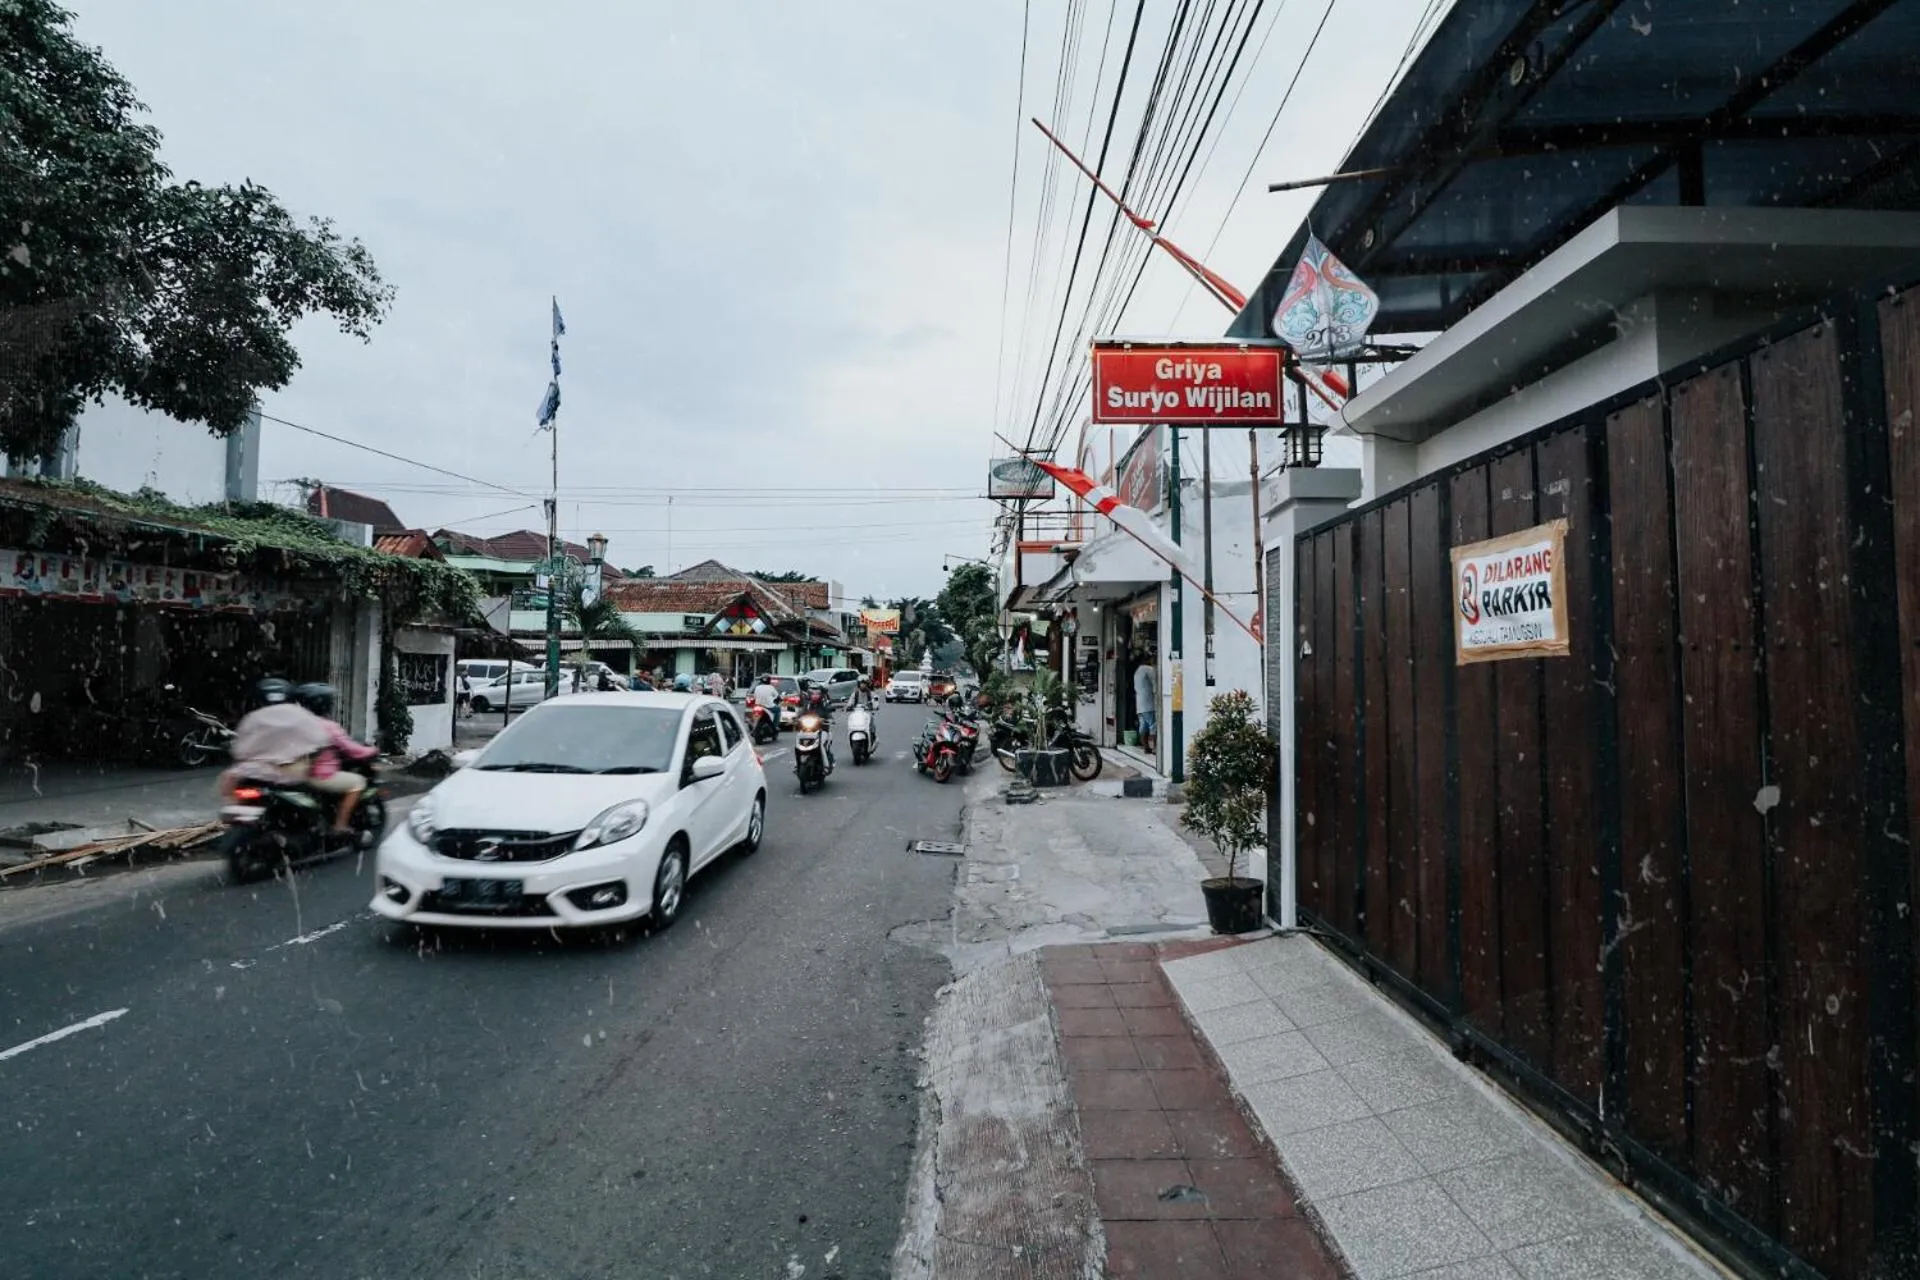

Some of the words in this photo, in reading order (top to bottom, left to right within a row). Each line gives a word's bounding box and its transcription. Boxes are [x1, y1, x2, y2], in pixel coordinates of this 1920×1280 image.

[1155, 358, 1222, 384] Griya
[1108, 387, 1179, 413] Suryo
[1185, 387, 1272, 413] Wijilan
[1484, 550, 1552, 583] DILARANG
[1482, 580, 1552, 617] PARKIR
